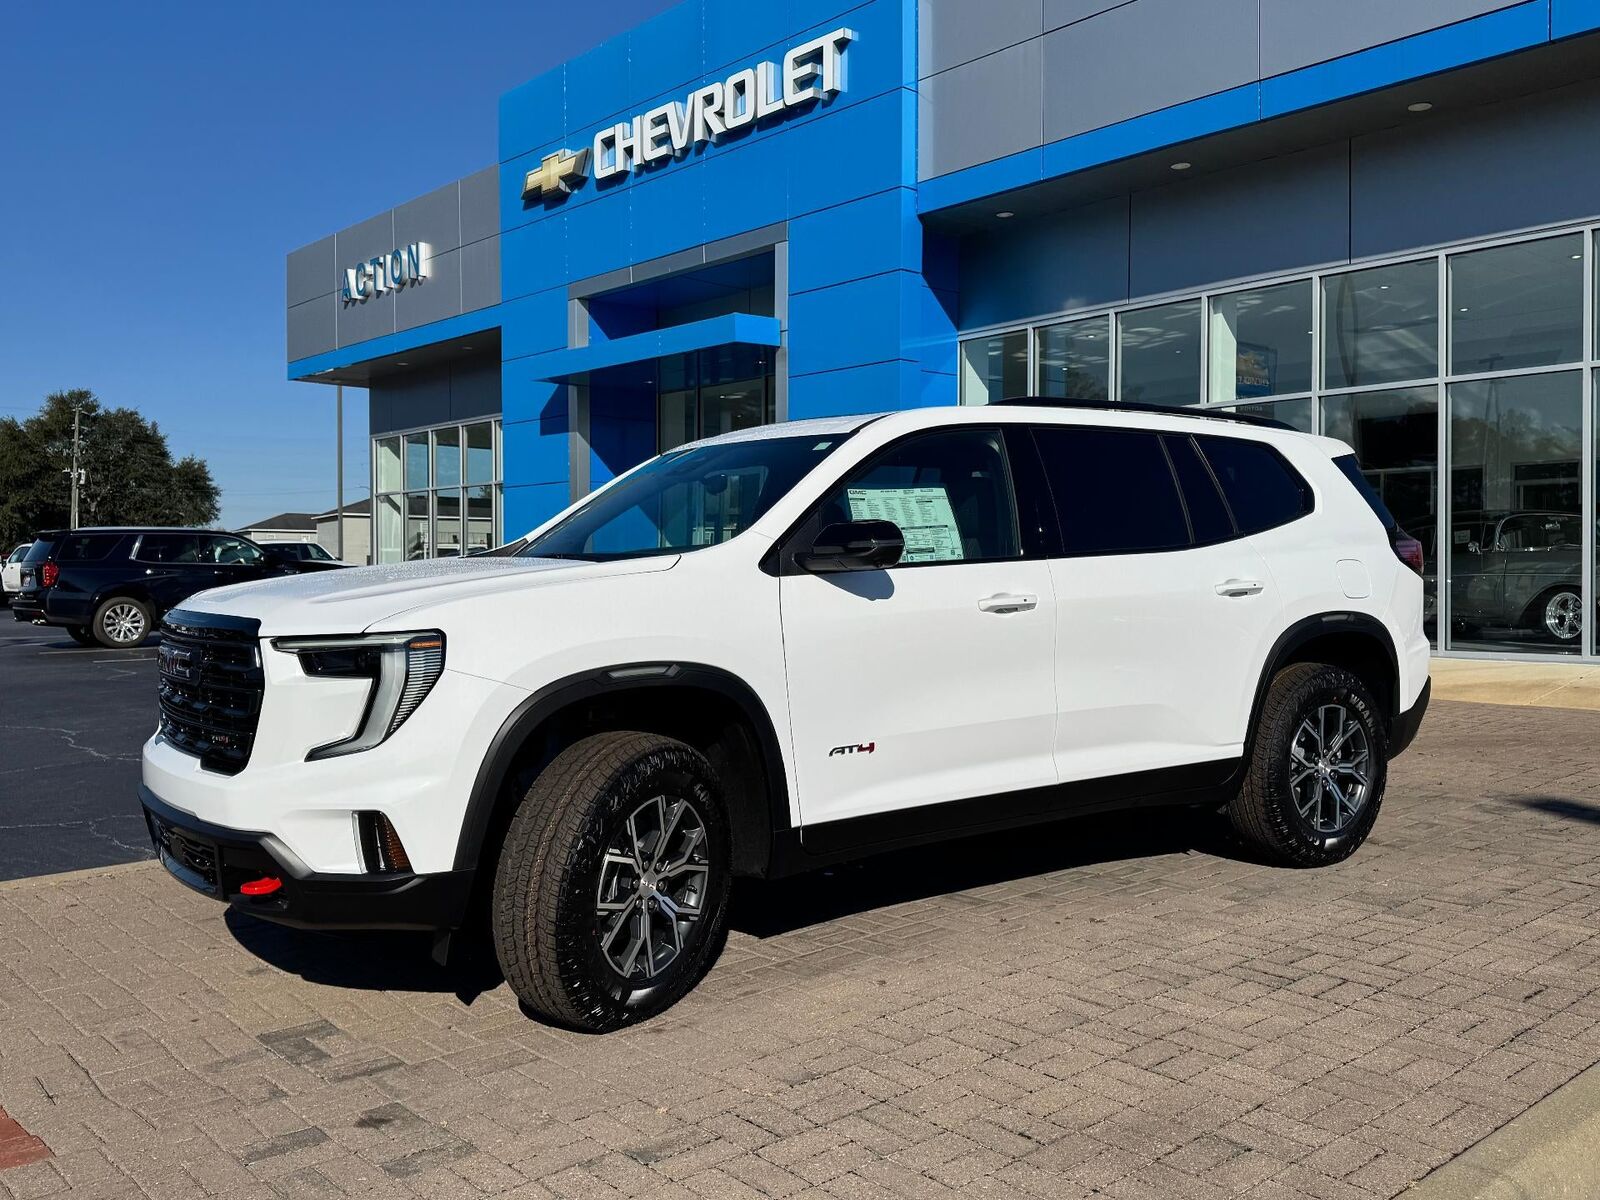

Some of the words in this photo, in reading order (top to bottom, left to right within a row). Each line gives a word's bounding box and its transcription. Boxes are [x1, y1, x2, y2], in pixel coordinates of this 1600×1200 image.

[594, 27, 857, 180] CHEVROLET
[342, 242, 426, 302] ACTION
[828, 742, 875, 757] AT4
